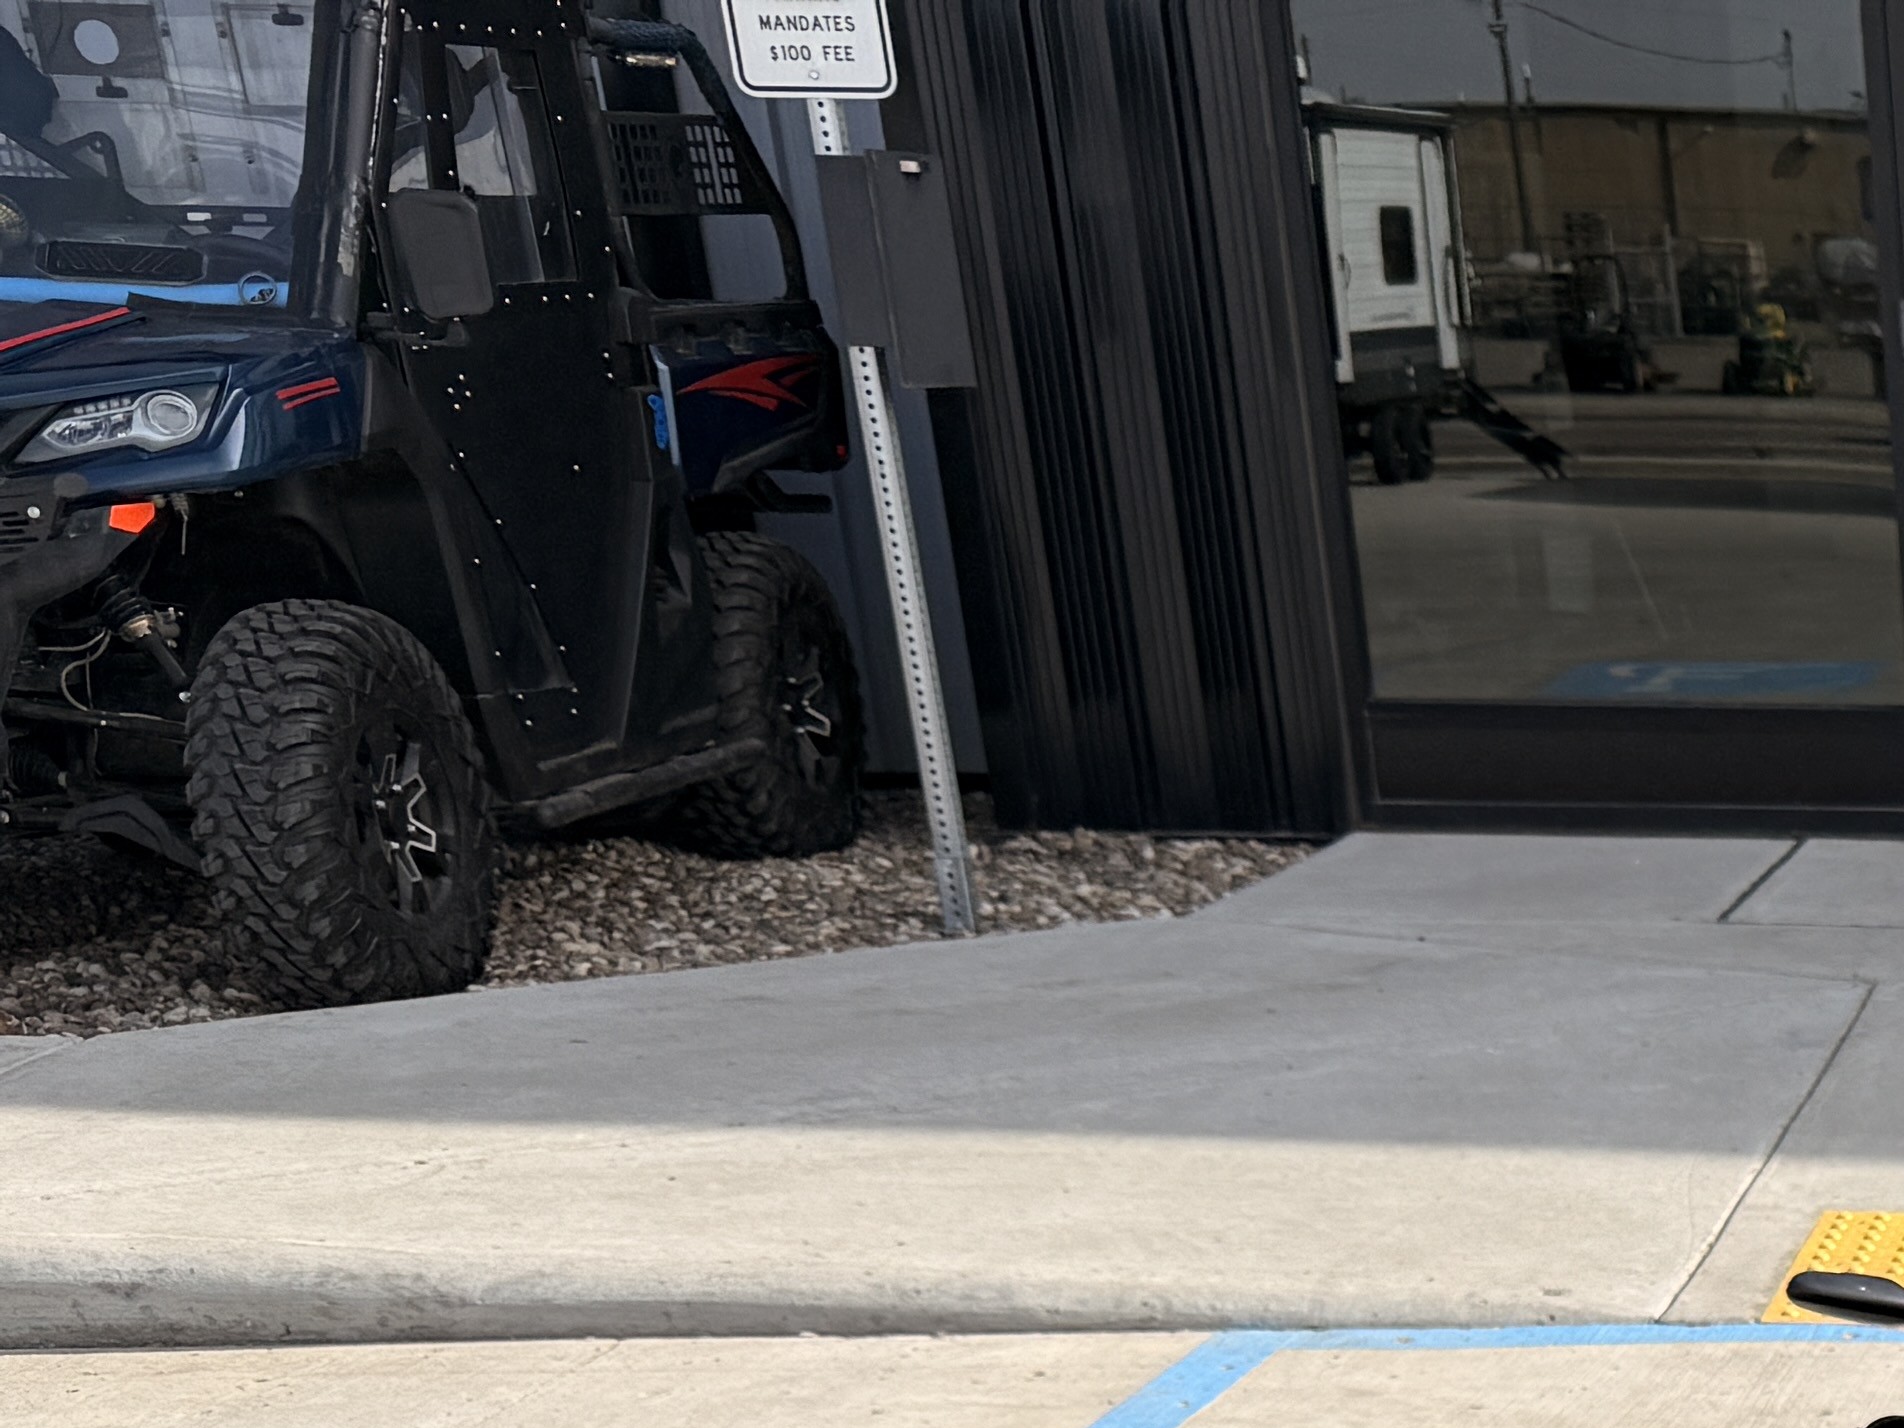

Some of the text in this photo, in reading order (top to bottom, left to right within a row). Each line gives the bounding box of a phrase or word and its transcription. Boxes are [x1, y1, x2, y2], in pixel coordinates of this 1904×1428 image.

[758, 14, 856, 32] MANDATES
[770, 45, 856, 62] $100 FEE
